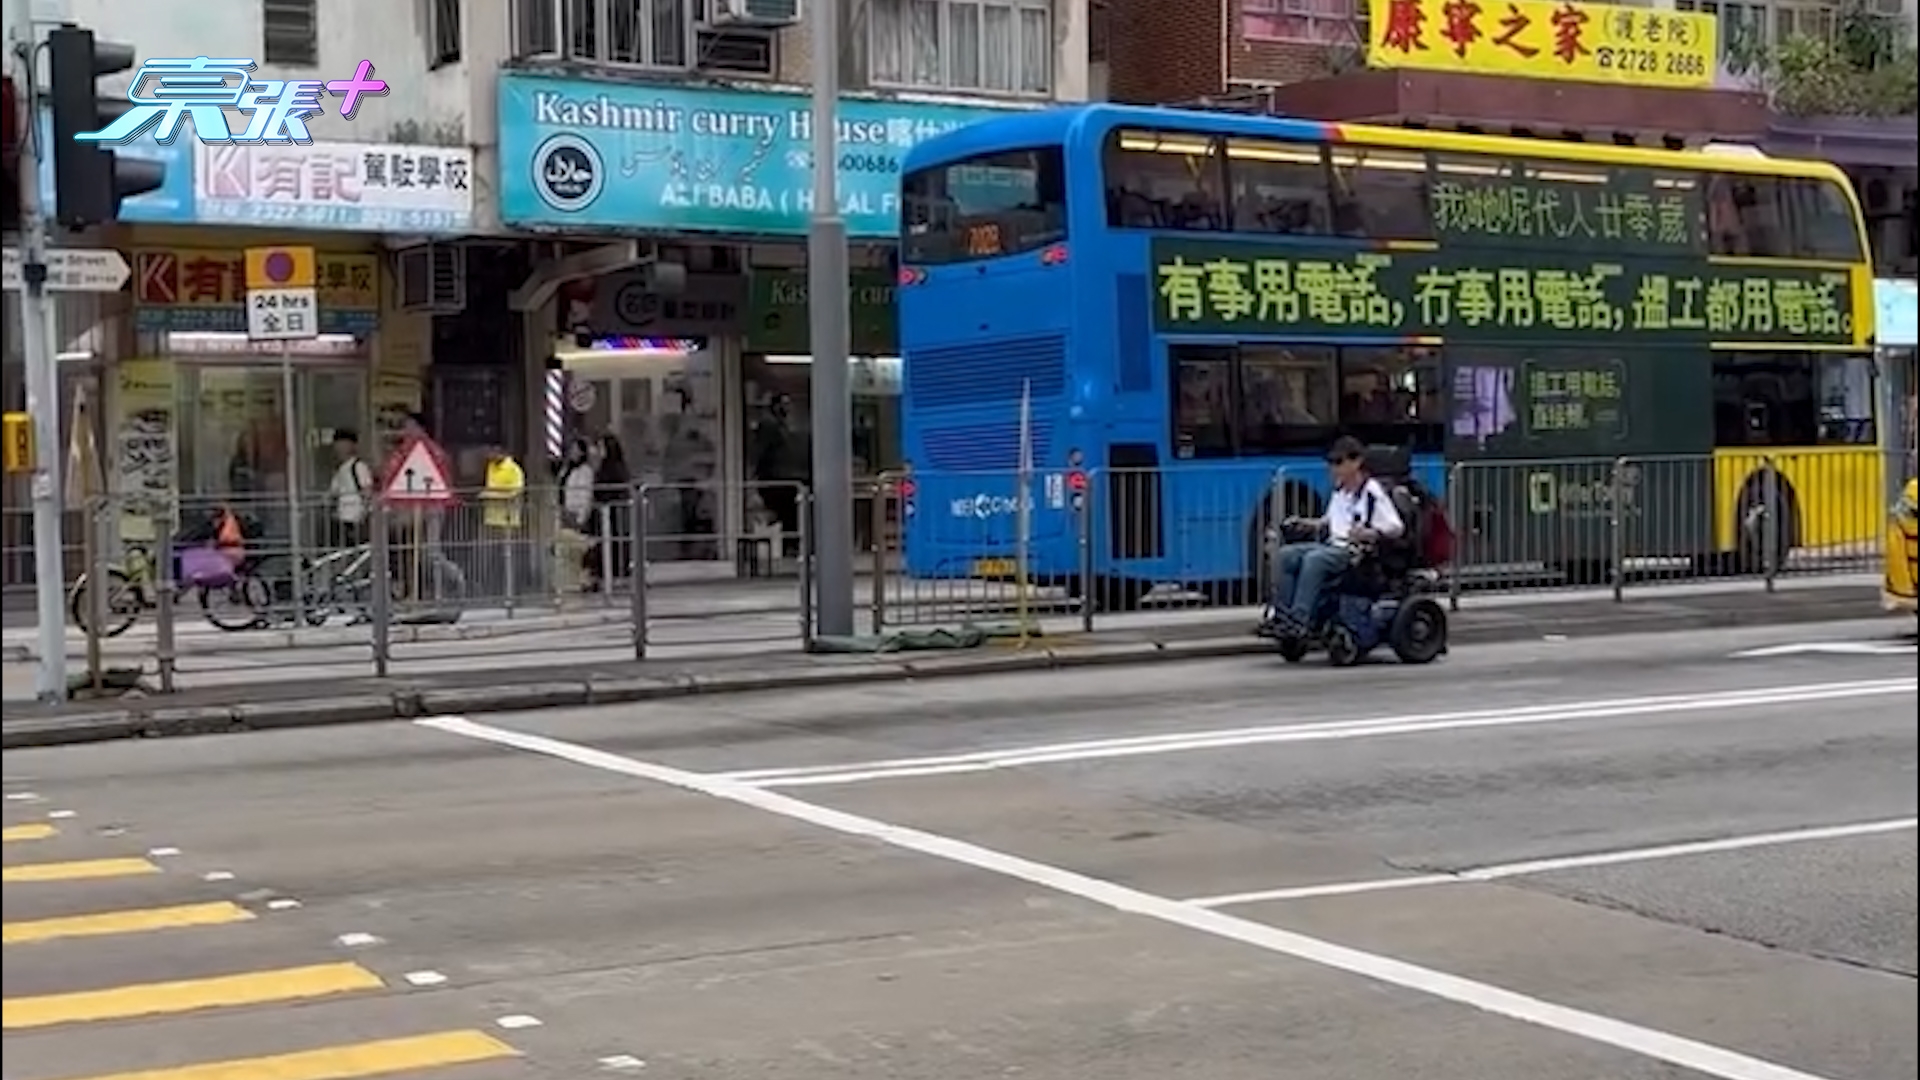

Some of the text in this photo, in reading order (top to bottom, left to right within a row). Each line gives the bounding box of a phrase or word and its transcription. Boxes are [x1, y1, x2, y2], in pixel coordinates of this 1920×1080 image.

[1382, 0, 1592, 63] 康寧之家
[1618, 48, 1658, 72] 2728
[535, 91, 682, 132] Kashmir
[692, 111, 778, 145] curry
[788, 111, 884, 143] Huse
[247, 153, 361, 203] 有記
[363, 152, 468, 190] 駕駛學校
[707, 186, 774, 212] BABA
[183, 257, 245, 303] 有
[255, 294, 310, 310] 24 hrs
[262, 312, 305, 333] 全日
